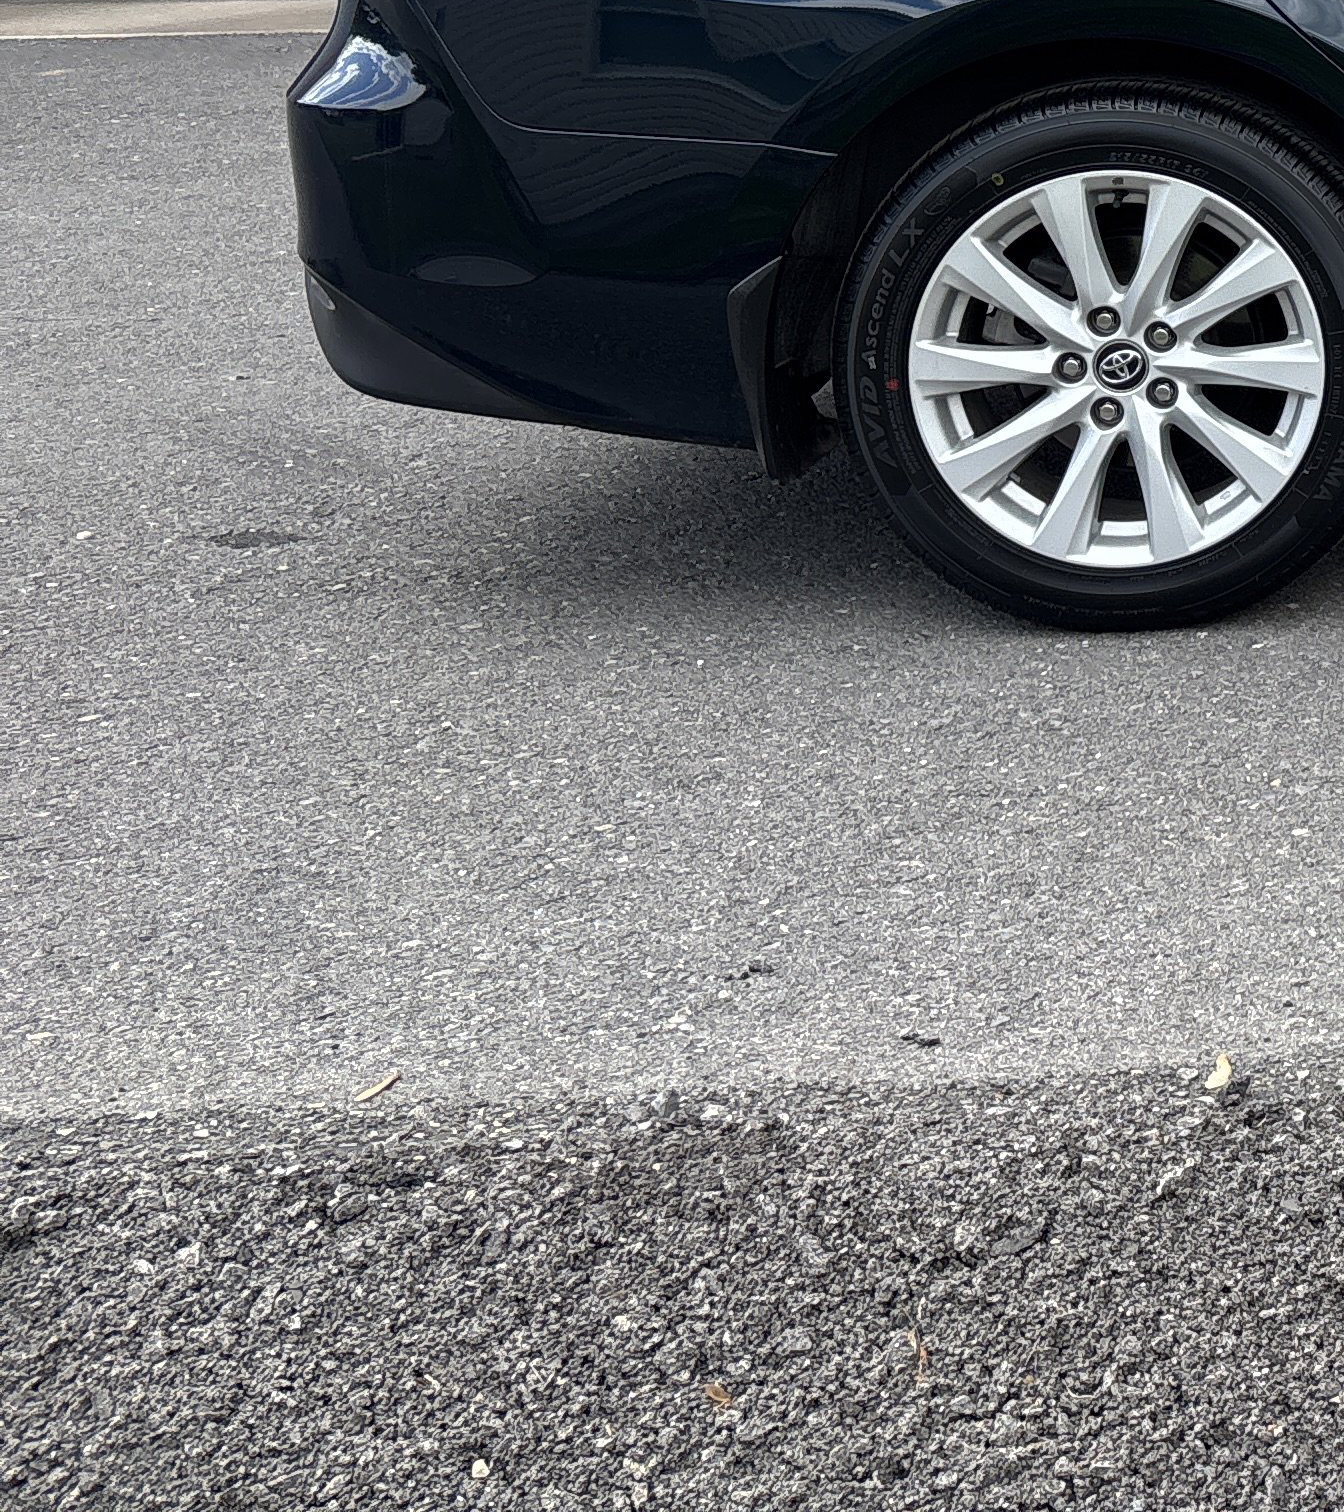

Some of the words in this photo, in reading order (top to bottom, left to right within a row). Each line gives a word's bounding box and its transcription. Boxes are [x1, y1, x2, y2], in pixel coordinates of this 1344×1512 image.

[888, 217, 925, 266] LX
[860, 267, 896, 370] Ascend
[859, 375, 898, 469] AVID
